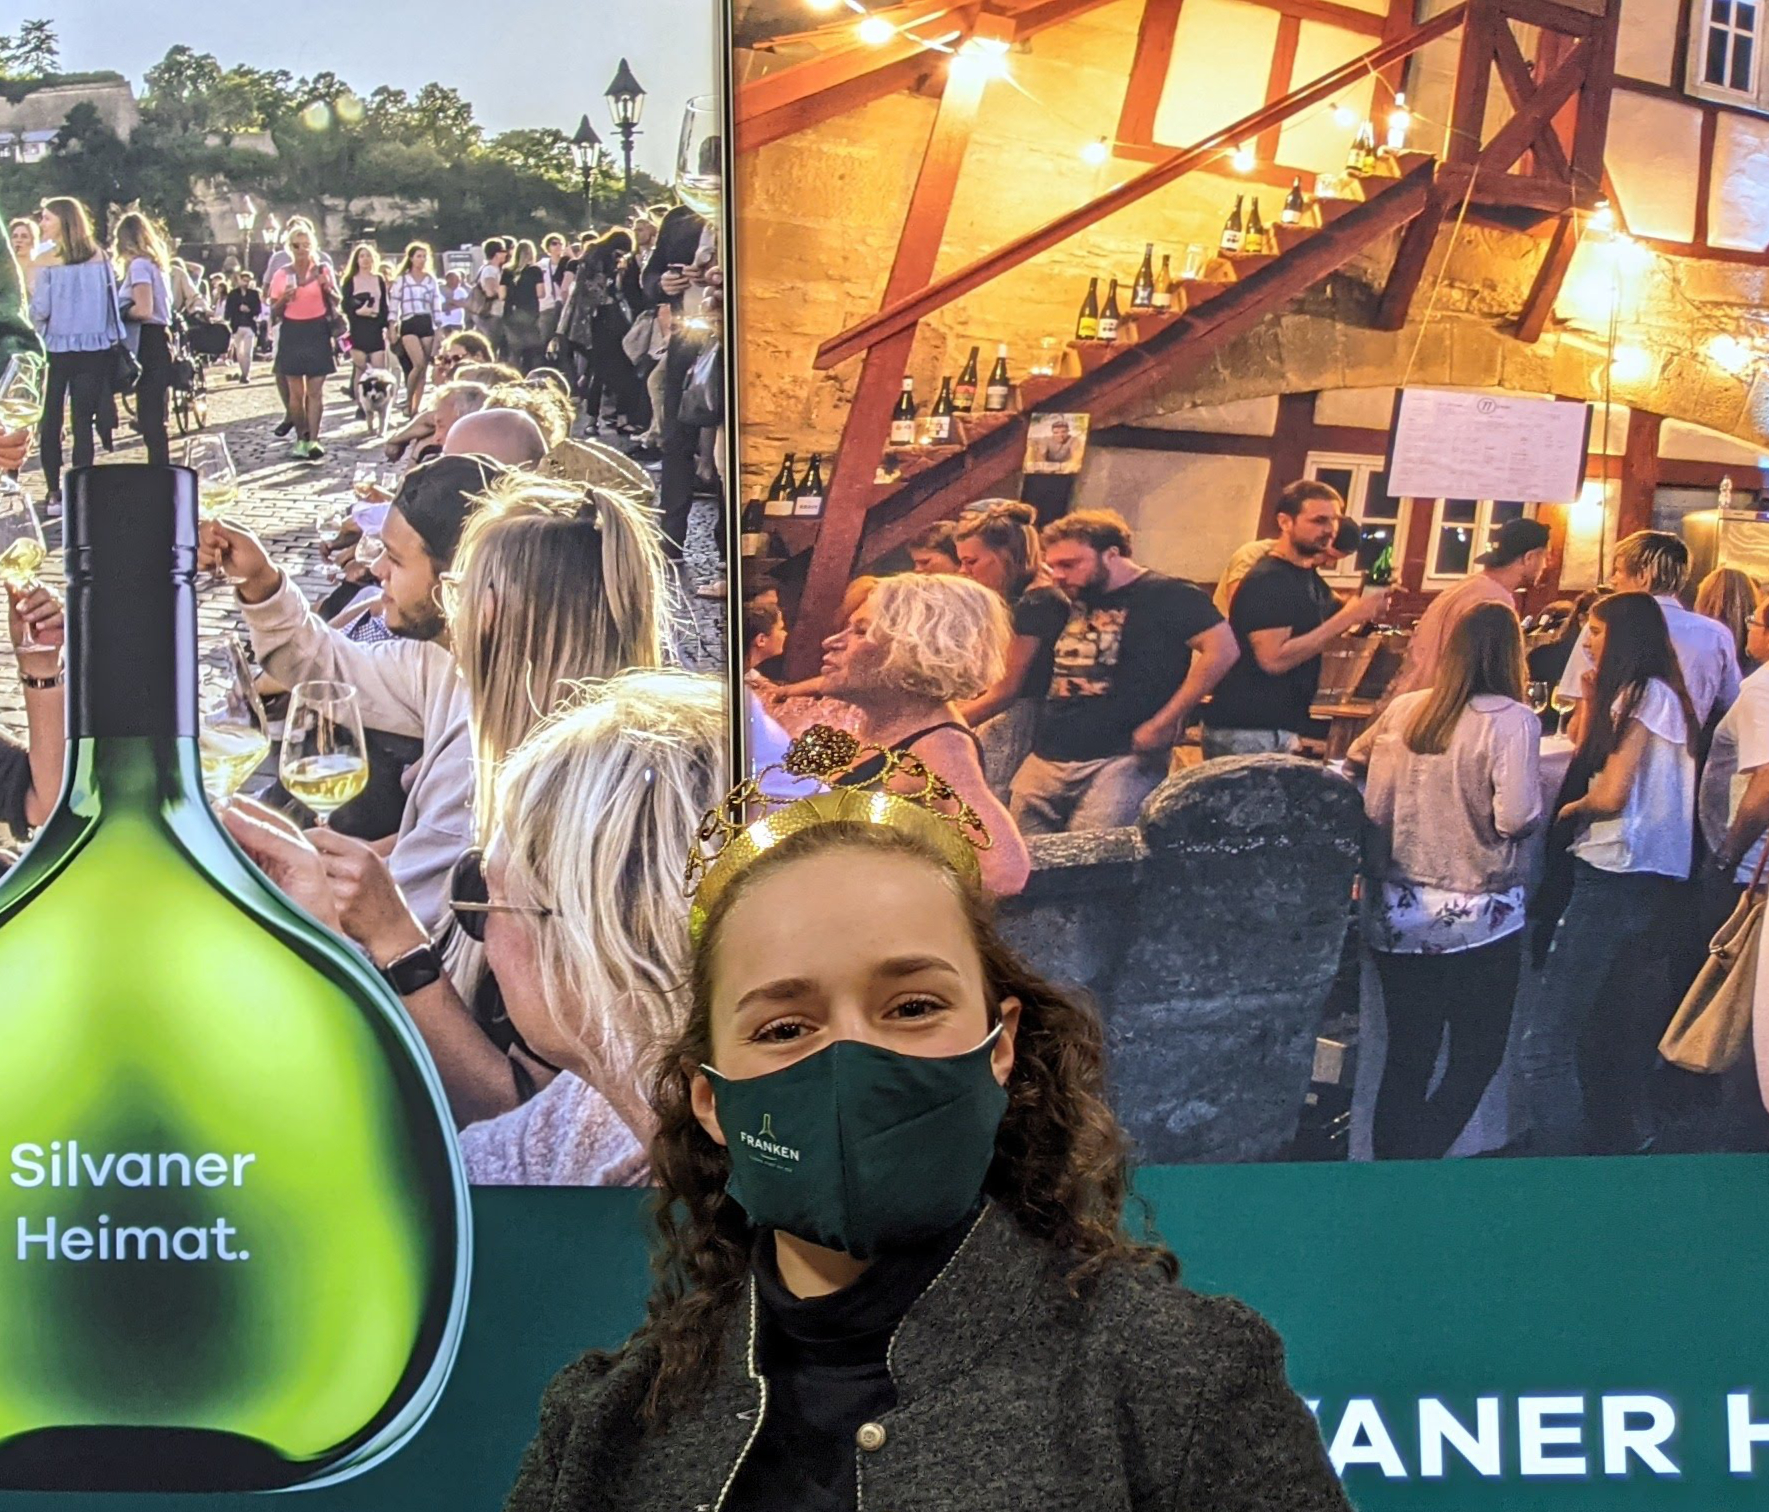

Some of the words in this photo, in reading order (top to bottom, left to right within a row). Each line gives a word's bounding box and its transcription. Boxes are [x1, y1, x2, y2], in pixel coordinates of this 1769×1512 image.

[10, 1141, 255, 1188] Silvaner
[740, 1131, 799, 1162] FRANKEN
[17, 1216, 250, 1261] Heimat.
[1306, 1394, 1681, 1478] ANER
